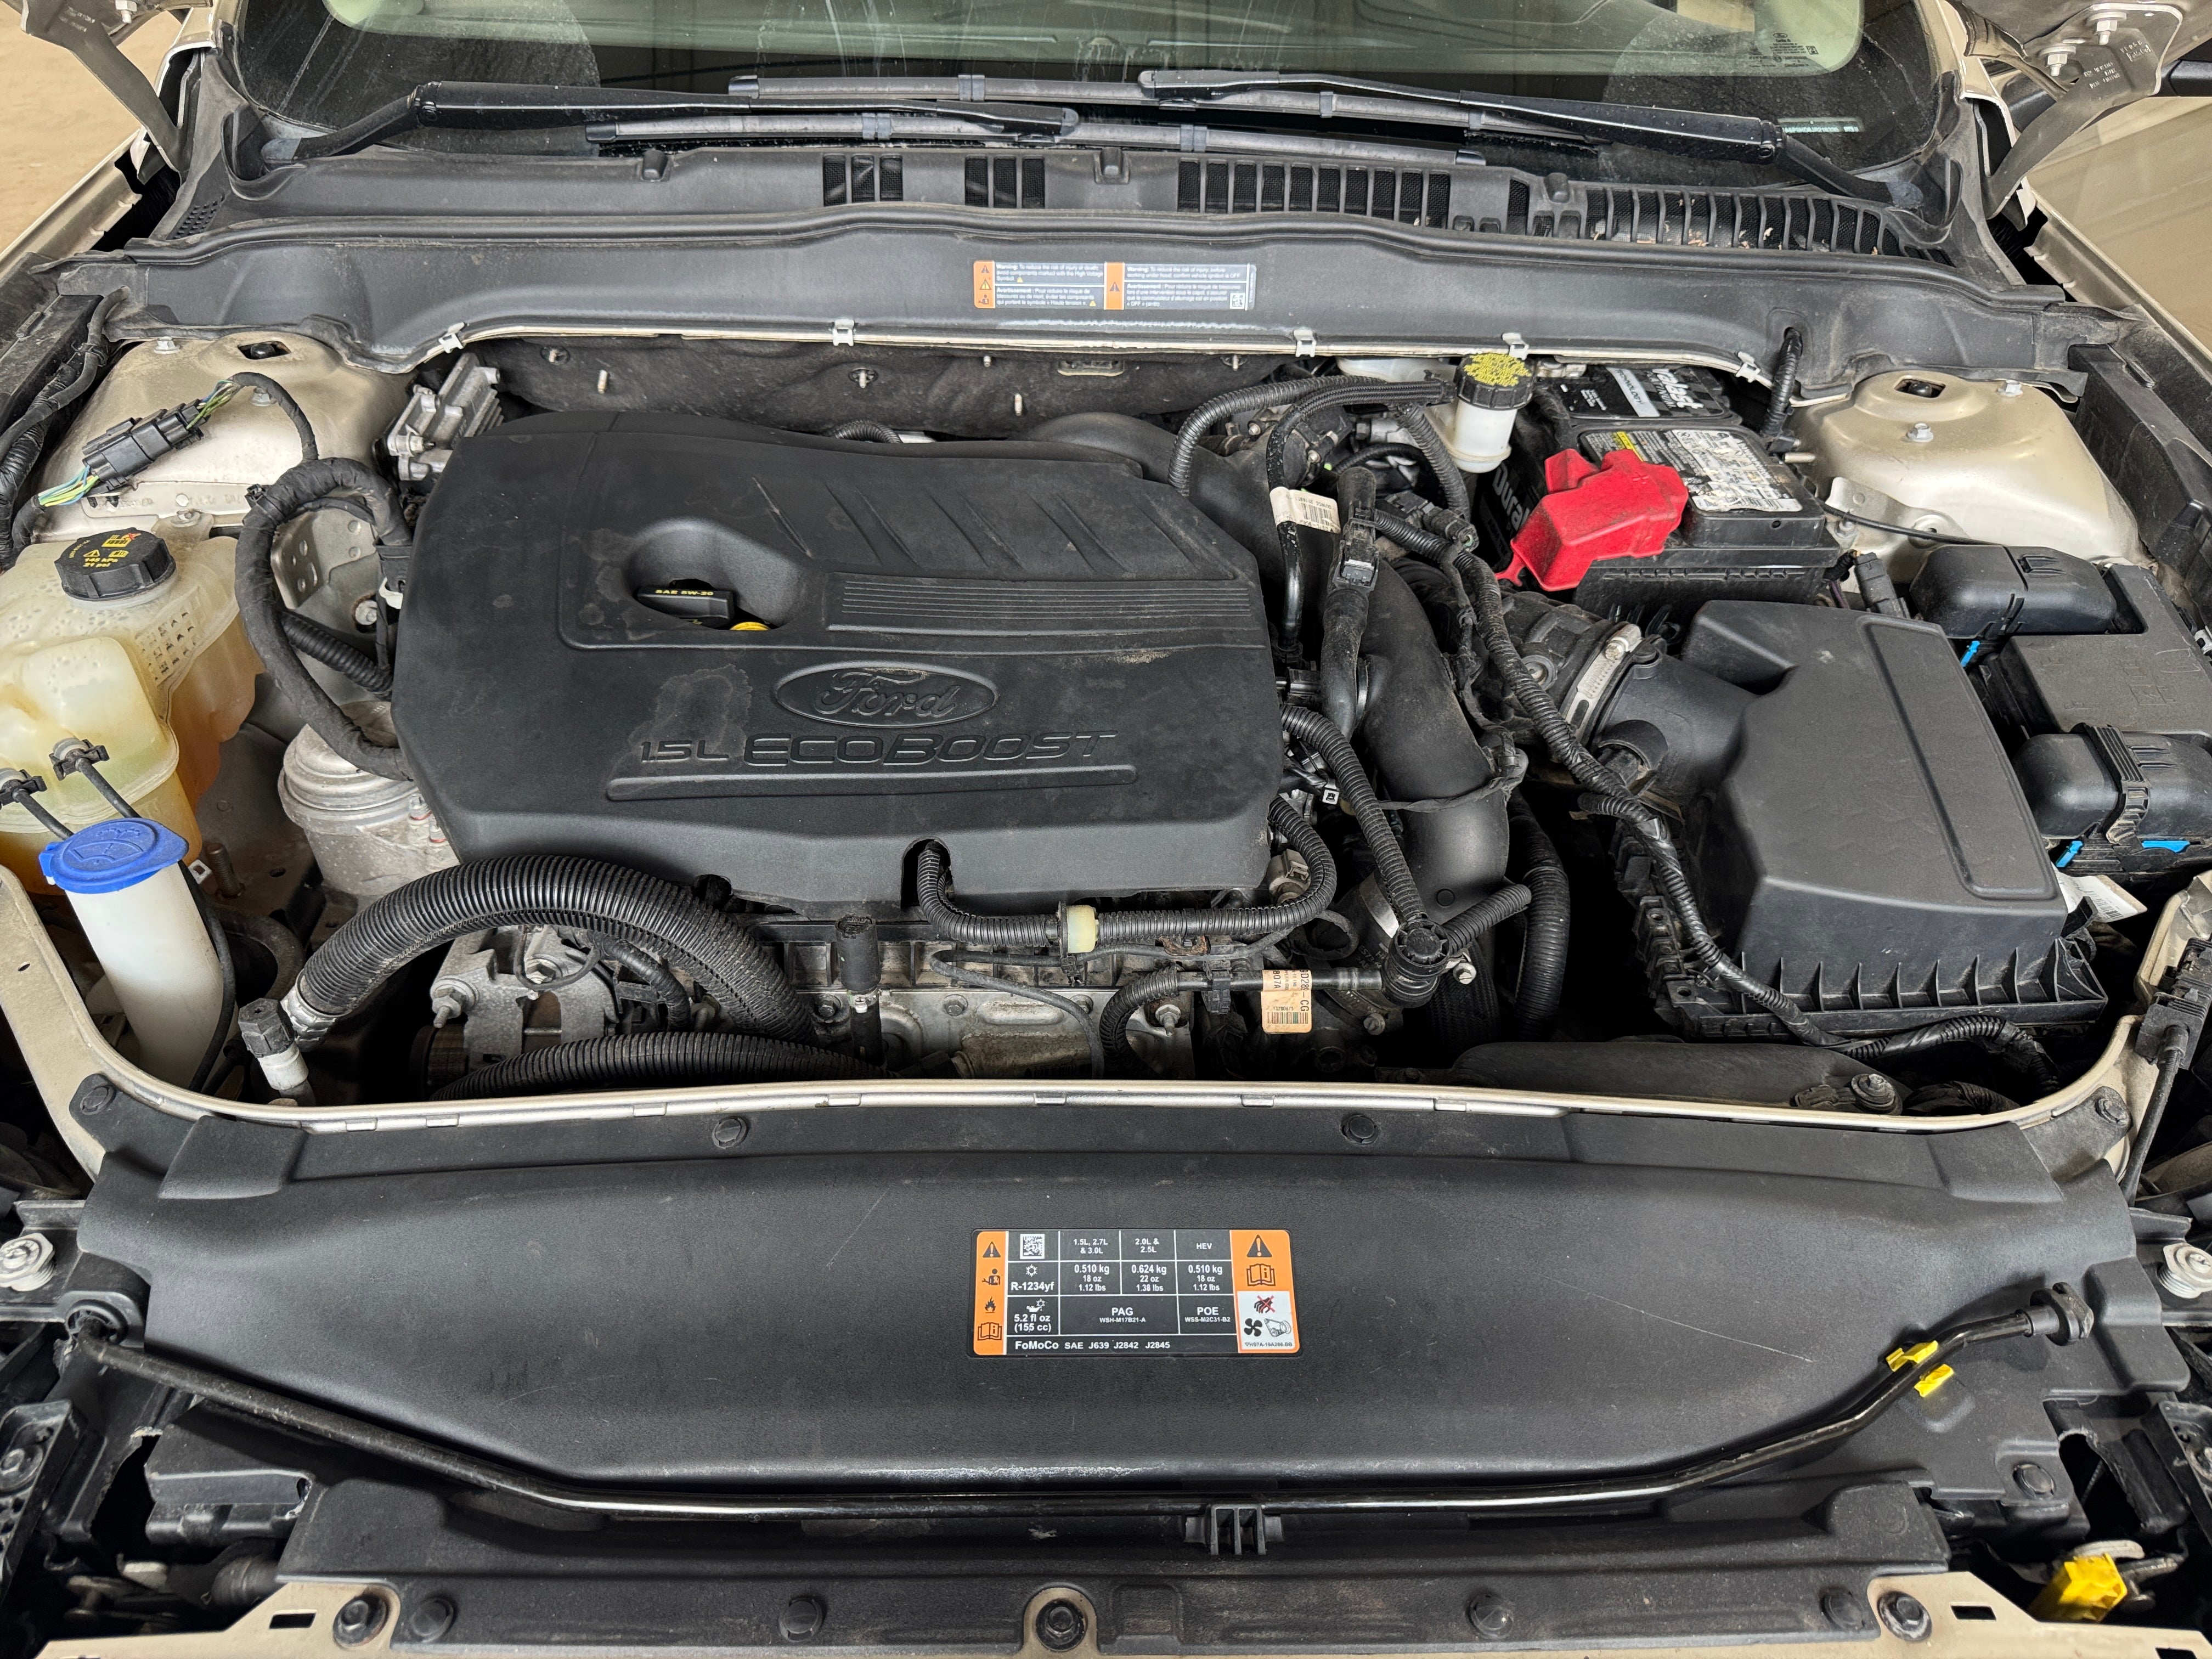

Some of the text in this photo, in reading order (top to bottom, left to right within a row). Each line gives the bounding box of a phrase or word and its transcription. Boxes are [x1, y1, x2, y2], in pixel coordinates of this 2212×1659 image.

[1652, 369, 1704, 409] ralast
[1492, 461, 1530, 531] Dural
[814, 669, 961, 718] Ford
[1074, 1264, 1110, 1274] 0.510 kg
[1156, 1265, 1166, 1275] kg
[1212, 1265, 1222, 1275] kg
[1011, 1282, 1054, 1293] R-1234yf
[1197, 1307, 1218, 1316] POE
[1014, 1323, 1051, 1333] (155 cc)
[1015, 1341, 1059, 1350] FoMoCo
